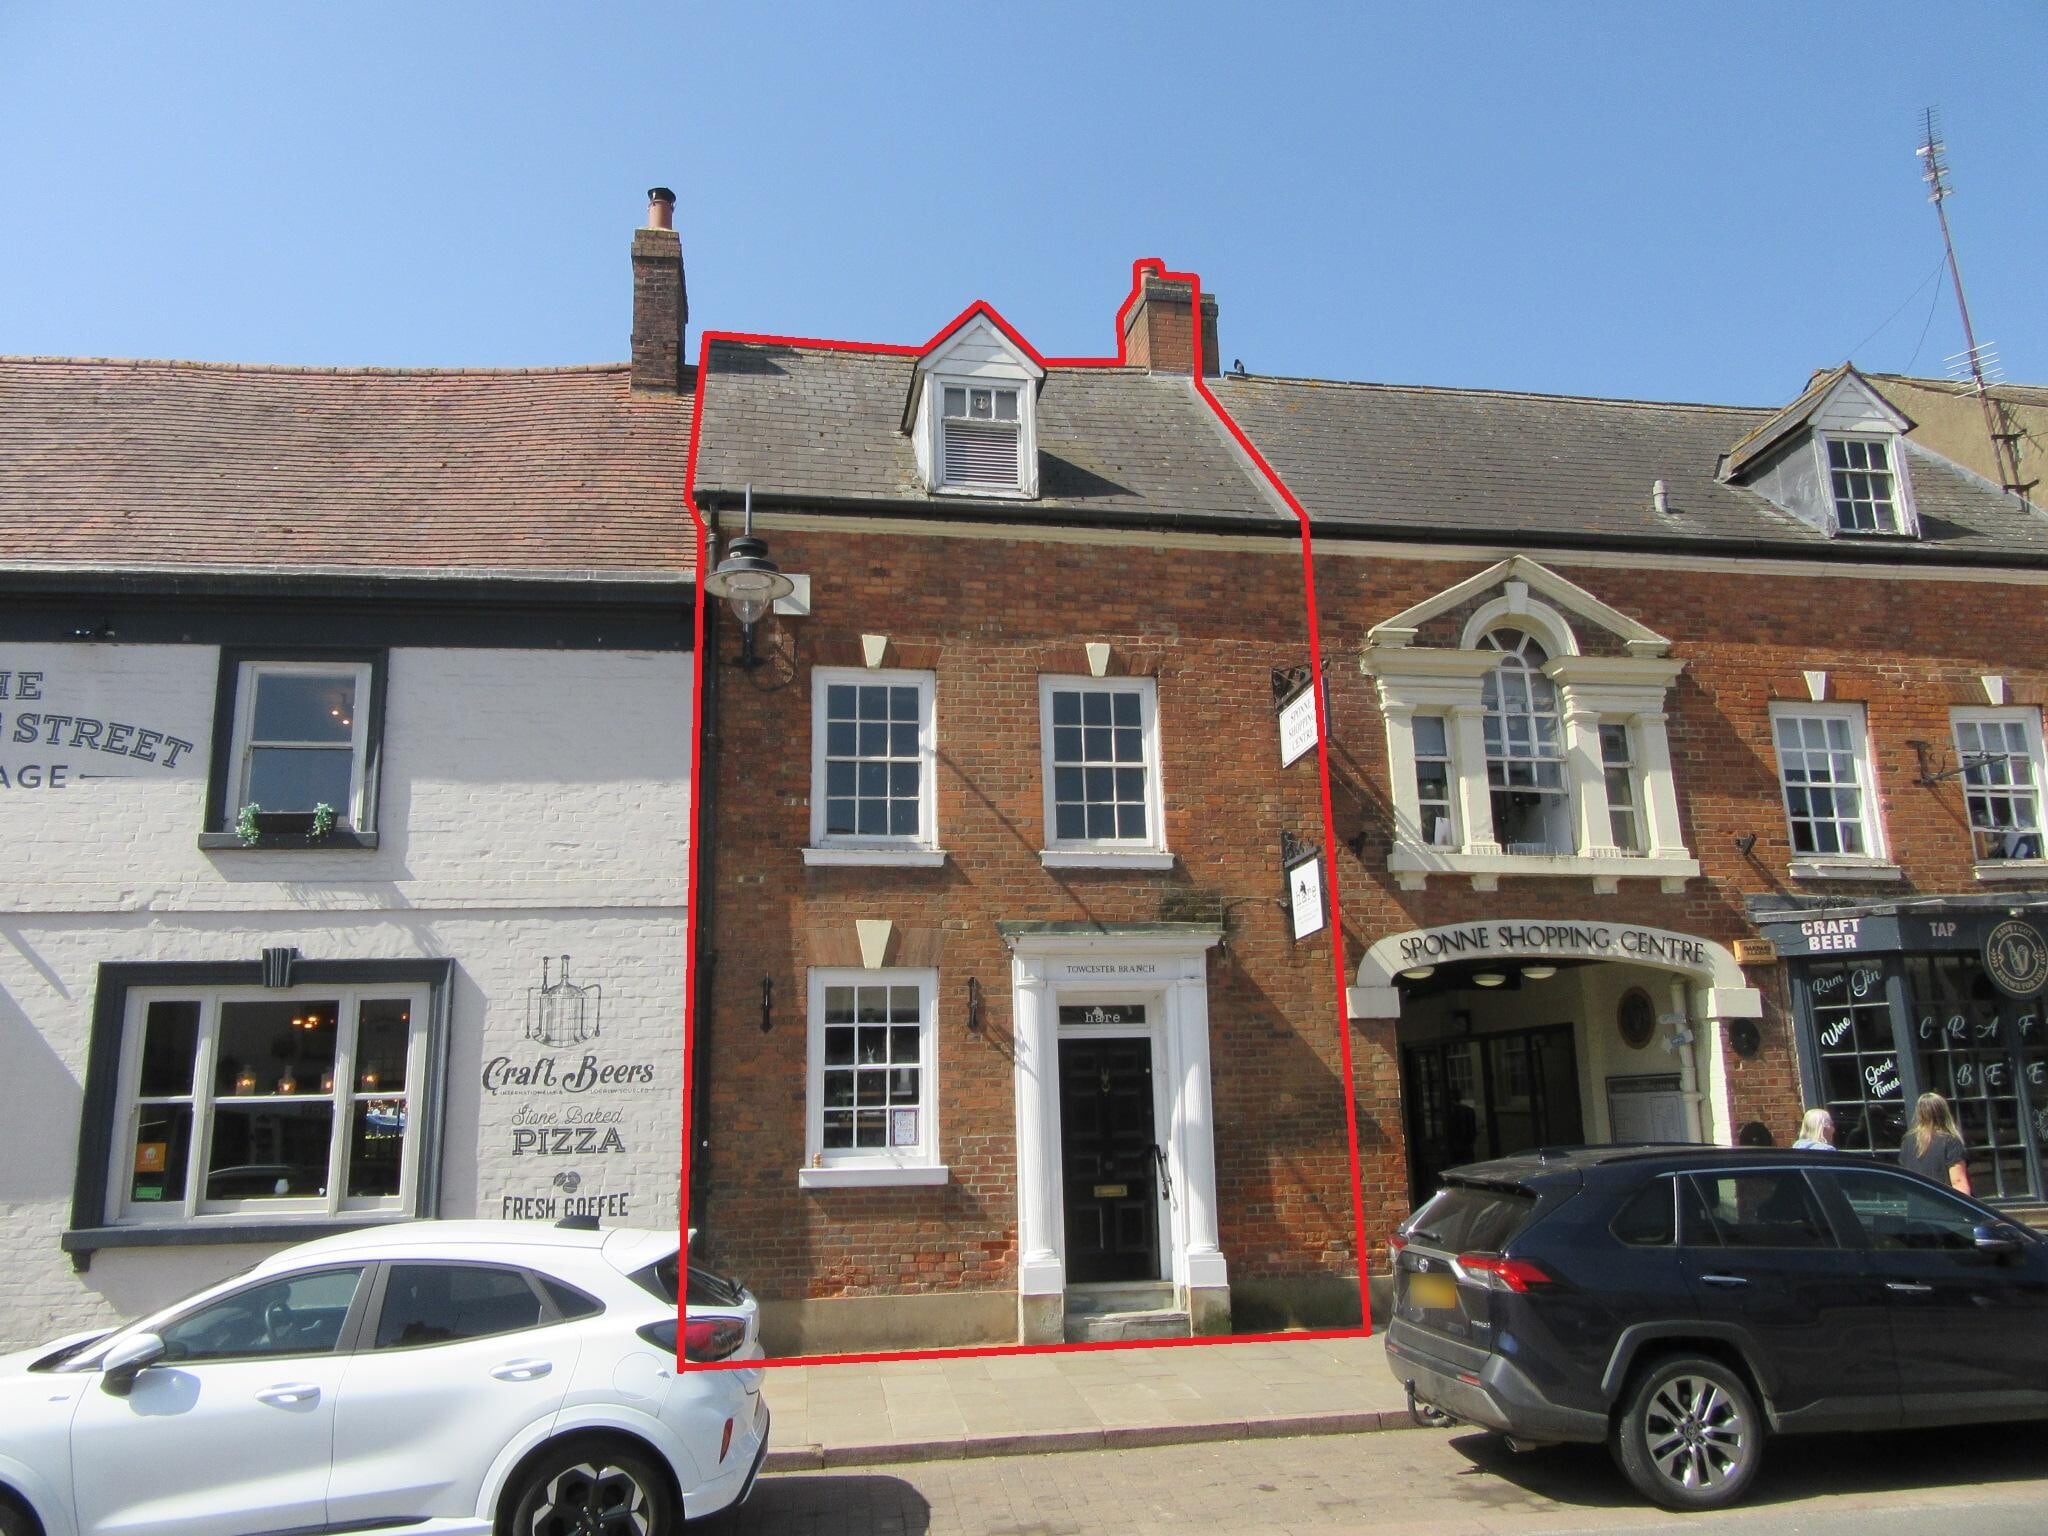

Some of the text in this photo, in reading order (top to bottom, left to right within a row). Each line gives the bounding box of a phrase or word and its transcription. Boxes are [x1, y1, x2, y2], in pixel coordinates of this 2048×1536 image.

[13, 712, 194, 769] STREET
[1801, 918, 1860, 937] CRAFT
[1929, 921, 1957, 937] TAP
[1399, 926, 1705, 964] SPONNE SHOPPING CENTRE
[1808, 933, 1857, 950] BEER
[1067, 965, 1155, 973] TOWCESTER BRANCH
[1813, 968, 1882, 997] Rum Gin
[1085, 1011, 1121, 1023] hare
[1919, 1014, 2048, 1040] CRAF
[1821, 1016, 1851, 1047] Wine
[482, 1055, 655, 1095] Craft Beers
[1865, 1059, 1893, 1086] Good
[1871, 1077, 1901, 1099] Times
[512, 1104, 624, 1126] Stone Baked
[512, 1127, 626, 1155] PIZZA
[502, 1192, 629, 1220] FRESH COFFEE
